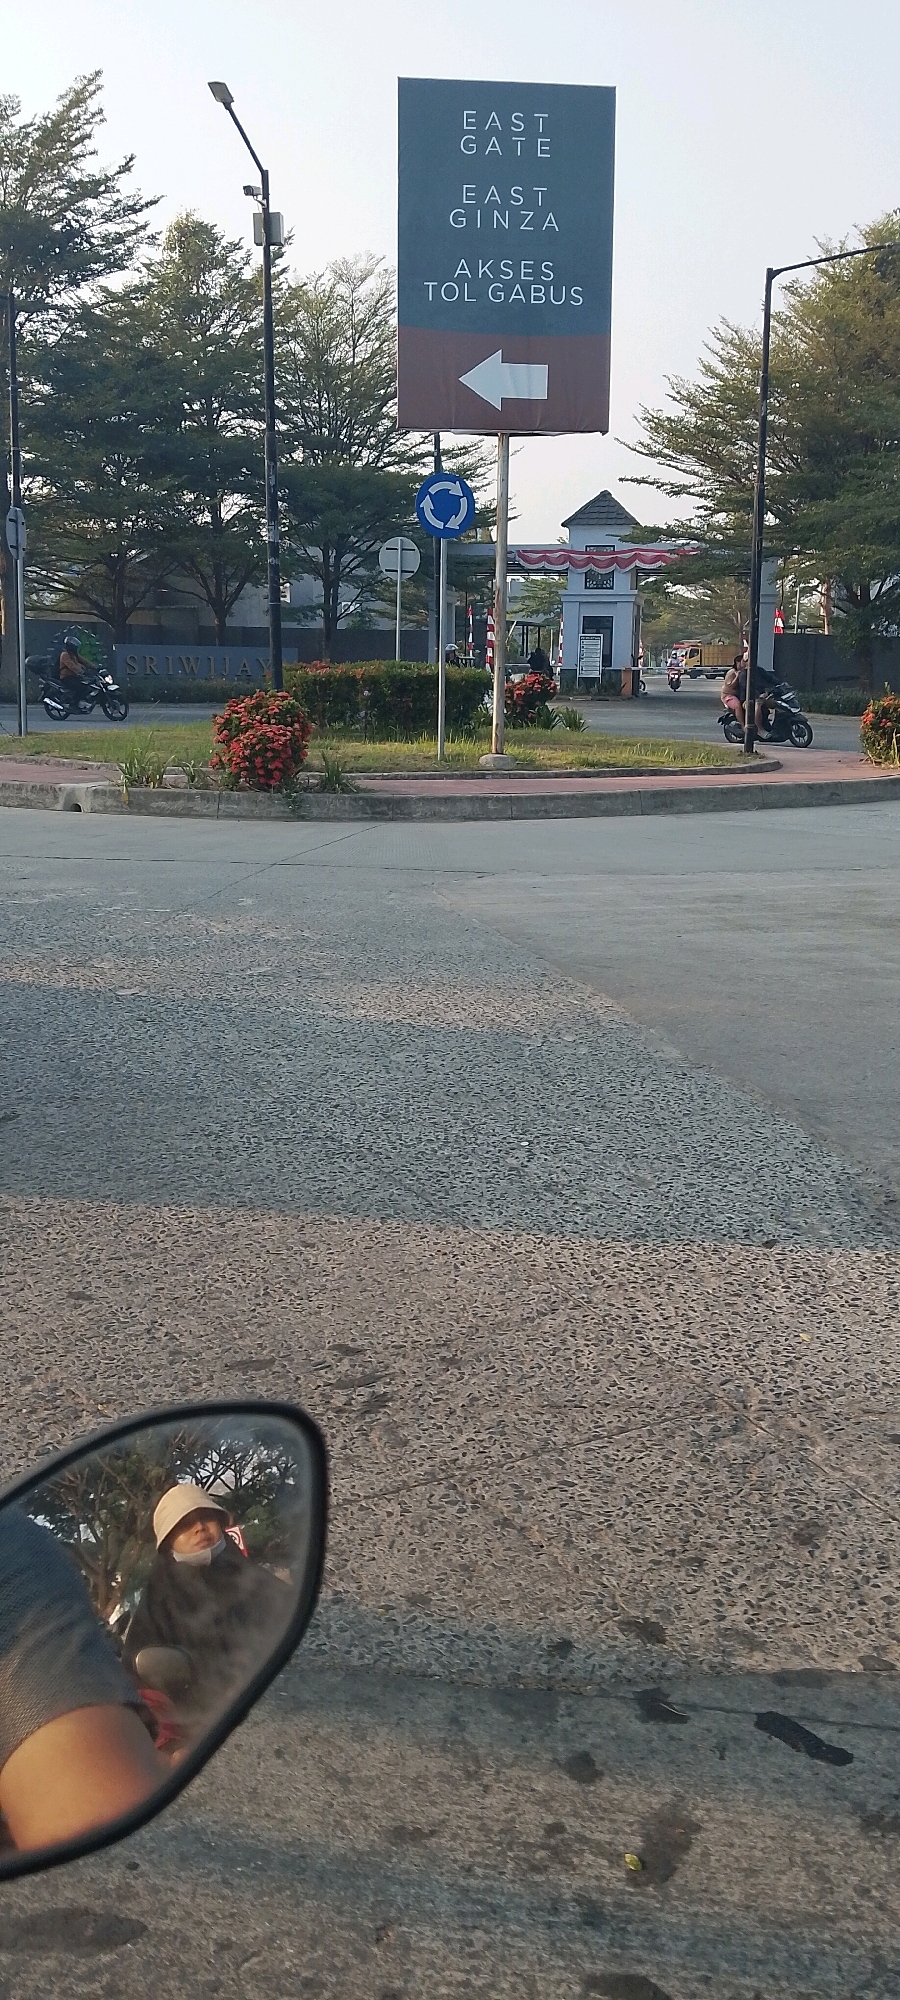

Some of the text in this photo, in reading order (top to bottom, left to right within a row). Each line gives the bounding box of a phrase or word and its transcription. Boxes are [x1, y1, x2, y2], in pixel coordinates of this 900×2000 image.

[462, 110, 549, 133] EAST
[460, 134, 551, 158] GATE
[462, 184, 548, 207] EAST
[449, 208, 560, 232] GINZA
[453, 258, 555, 281] AKSES
[423, 281, 583, 306] TOL GABUS
[125, 654, 273, 677] SRIWIJAY
